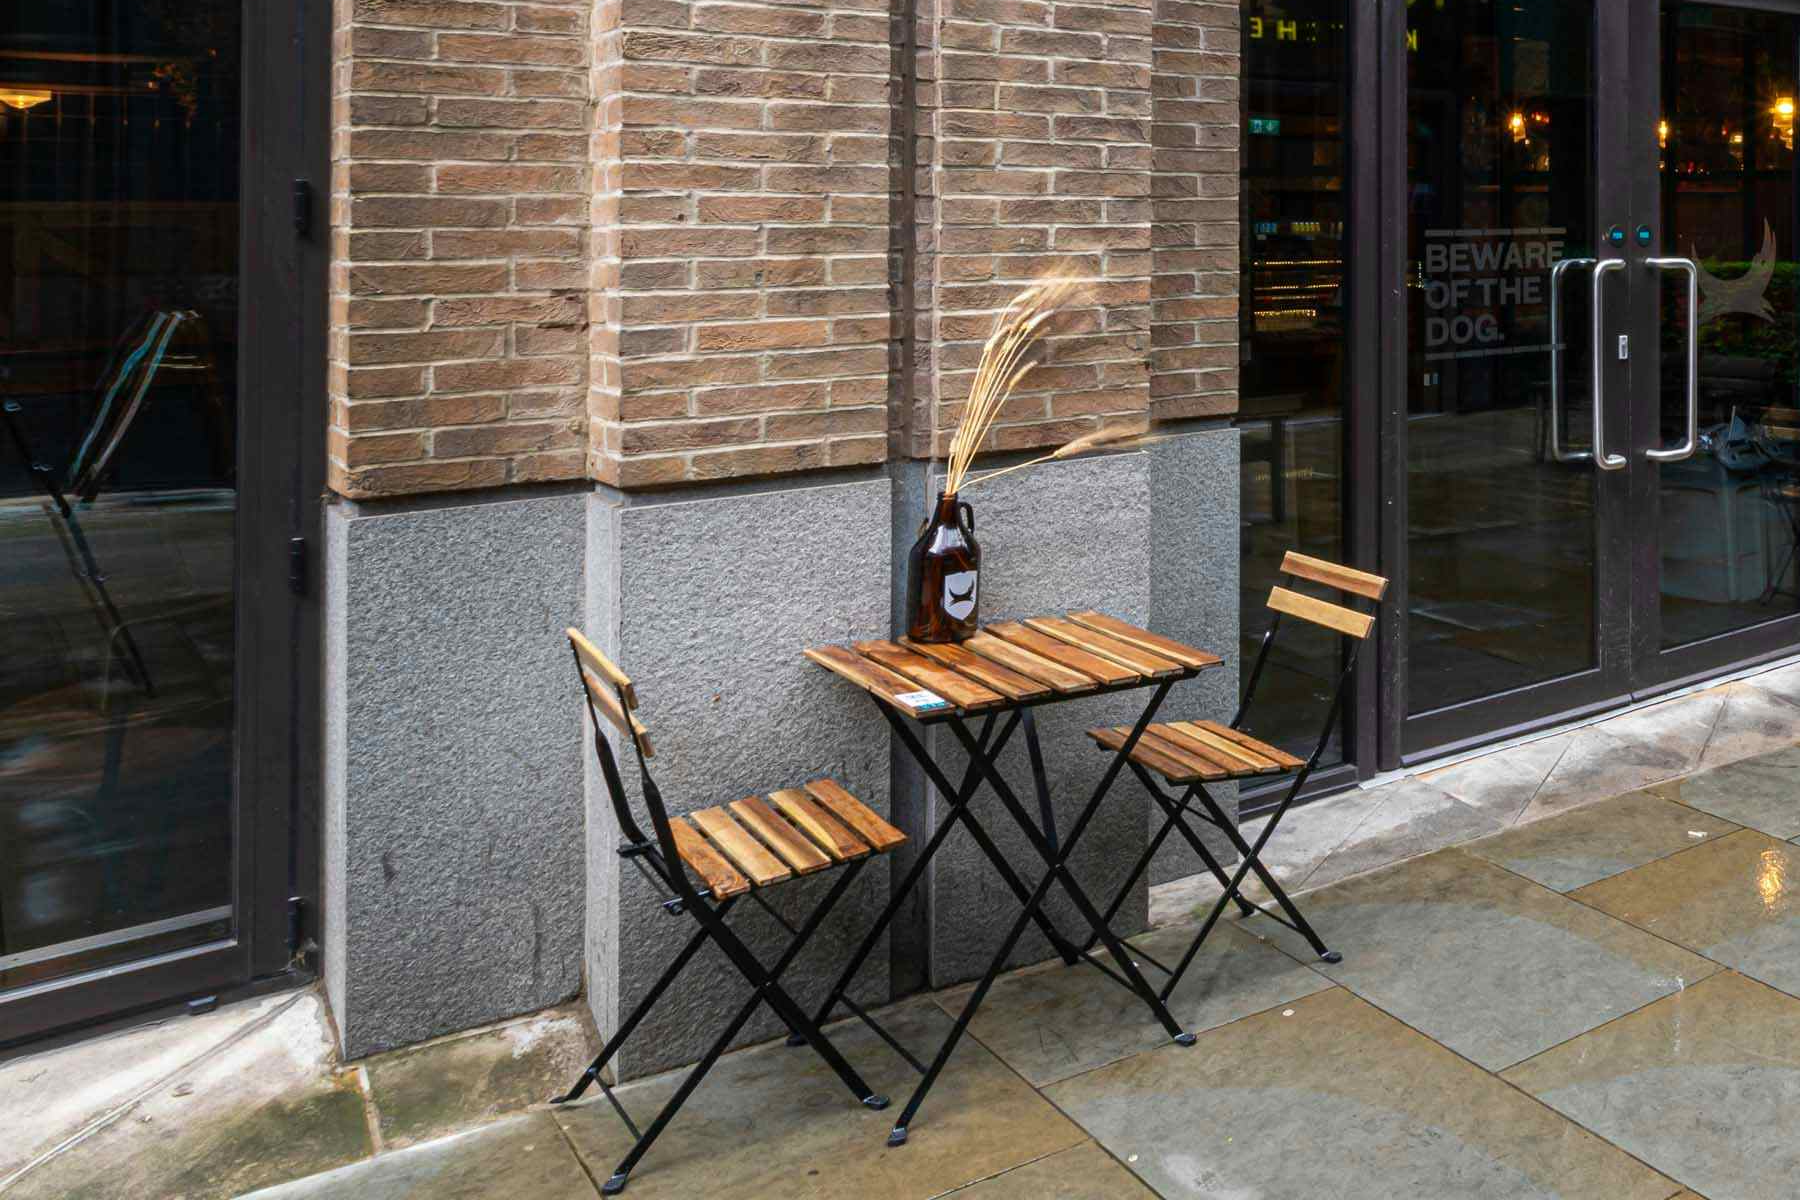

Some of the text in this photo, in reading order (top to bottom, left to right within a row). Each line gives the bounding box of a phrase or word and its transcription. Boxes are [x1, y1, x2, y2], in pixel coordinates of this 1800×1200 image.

[1424, 276, 1544, 310] OF THE
[1424, 313, 1505, 348] DOG.
